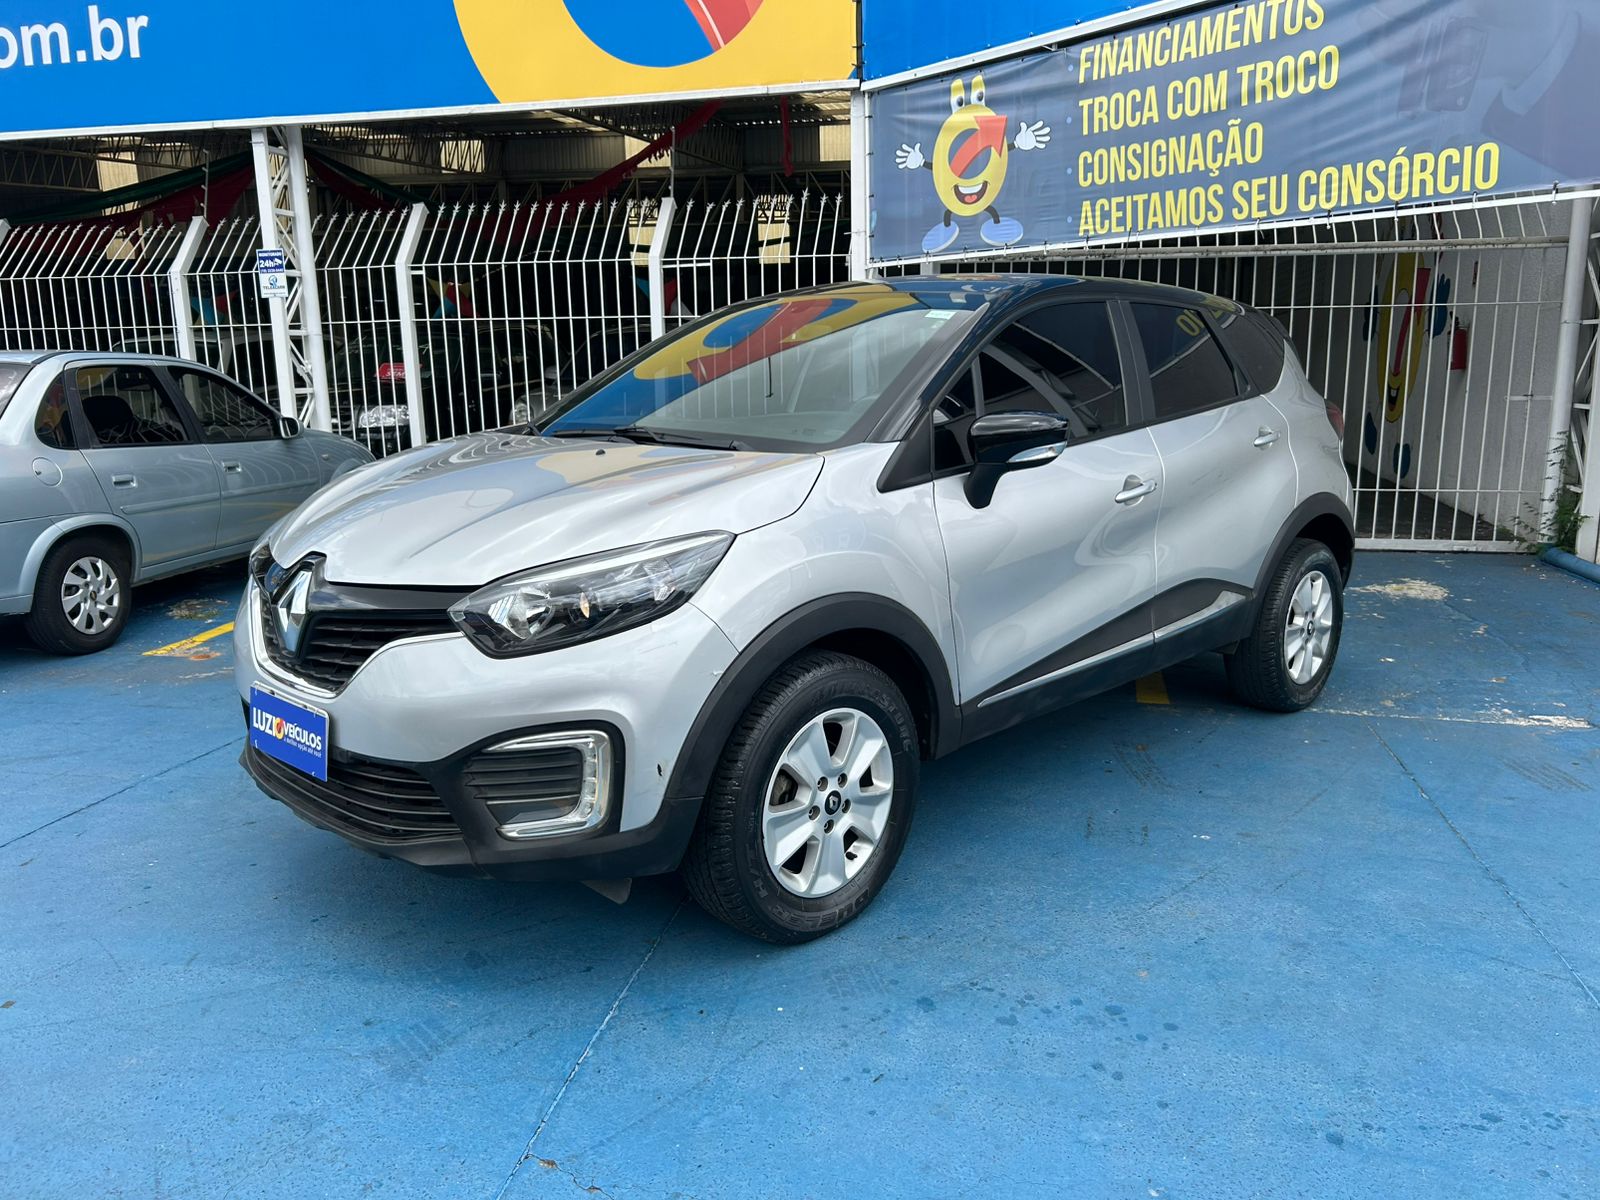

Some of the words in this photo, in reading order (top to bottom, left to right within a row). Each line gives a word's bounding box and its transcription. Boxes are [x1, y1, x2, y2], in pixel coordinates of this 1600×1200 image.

[1078, 0, 1325, 84] FINANCIAMENTOS
[1078, 85, 1159, 136] TROCA
[1166, 69, 1229, 120] COM
[1236, 45, 1340, 107] TROCO
[1078, 118, 1264, 188] CONSIGNAÇÃO
[1079, 183, 1224, 237] ACEITAMOS
[1231, 173, 1289, 220] SEU
[1297, 142, 1500, 212] CONSÓRCIO
[259, 259, 273, 268] 24h
[253, 707, 284, 740] LUZIO
[283, 720, 322, 751] VEÍCULOS
